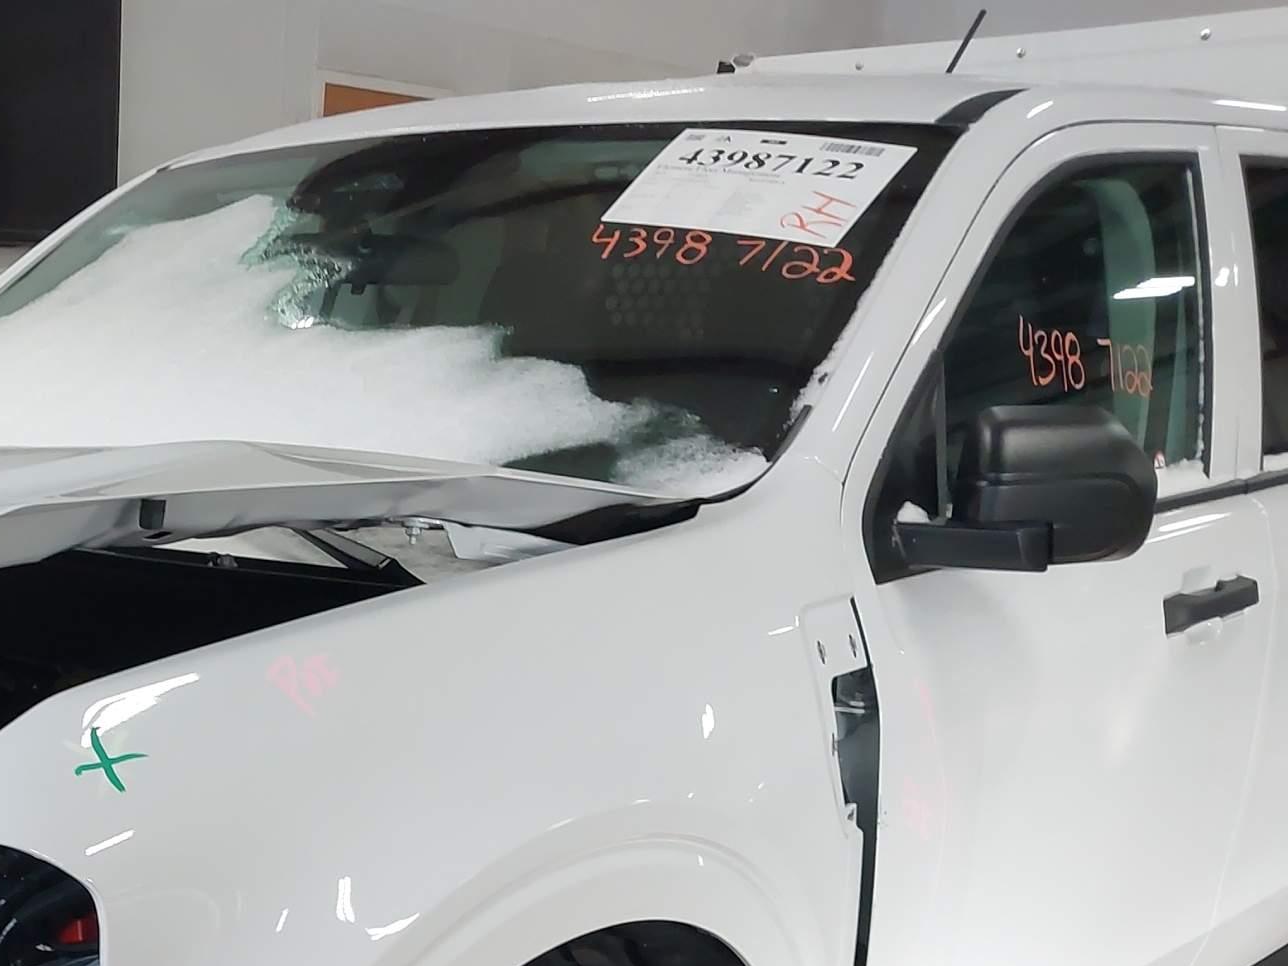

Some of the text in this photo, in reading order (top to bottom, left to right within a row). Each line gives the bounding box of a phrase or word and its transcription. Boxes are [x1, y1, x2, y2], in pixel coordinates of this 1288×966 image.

[678, 147, 865, 180] 43987122
[591, 223, 856, 285] 4398 7122
[1018, 313, 1086, 393] 4398
